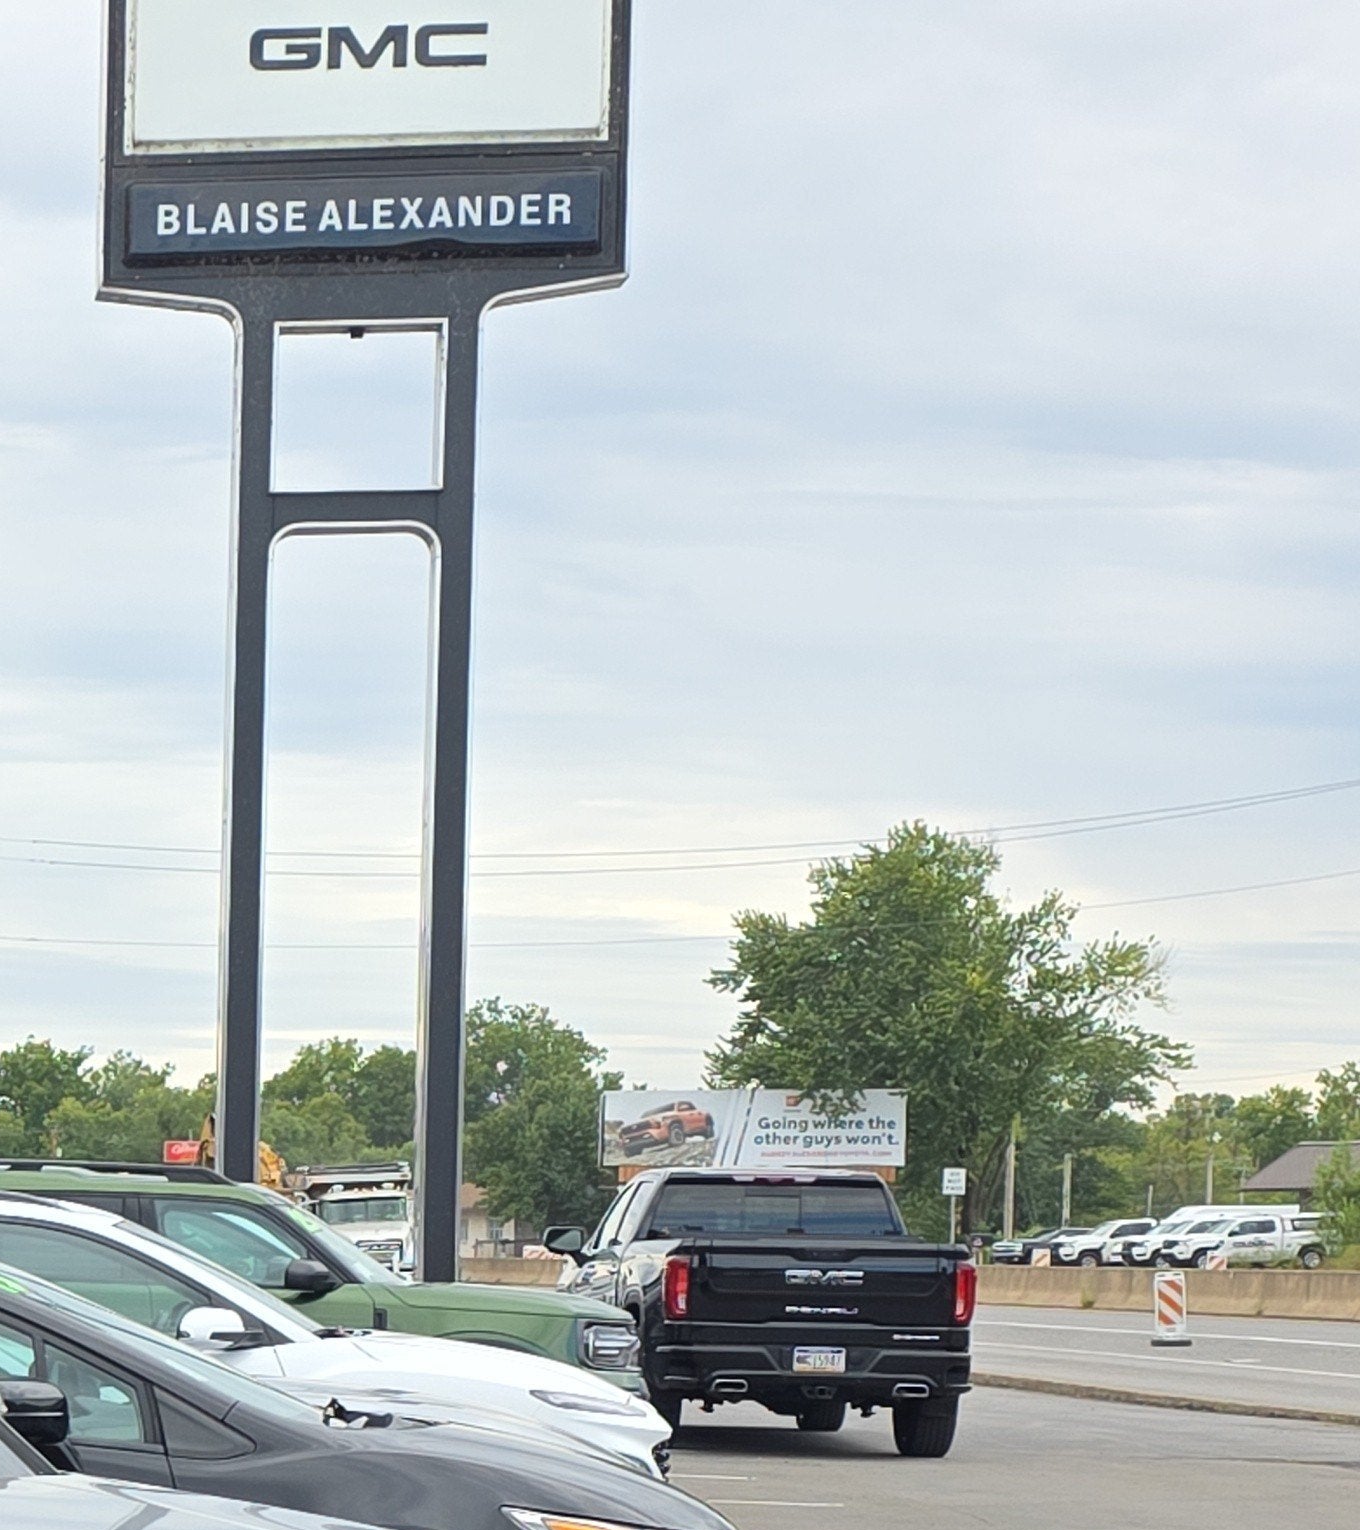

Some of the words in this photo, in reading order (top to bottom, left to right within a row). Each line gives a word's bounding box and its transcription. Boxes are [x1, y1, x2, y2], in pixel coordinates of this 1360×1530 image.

[248, 21, 489, 71] GMC
[156, 201, 307, 237] BLAISE
[317, 194, 572, 232] ALEXANDER
[757, 1116, 809, 1133] Going
[868, 1115, 897, 1130] the
[753, 1132, 799, 1146] other
[802, 1133, 843, 1149] guys
